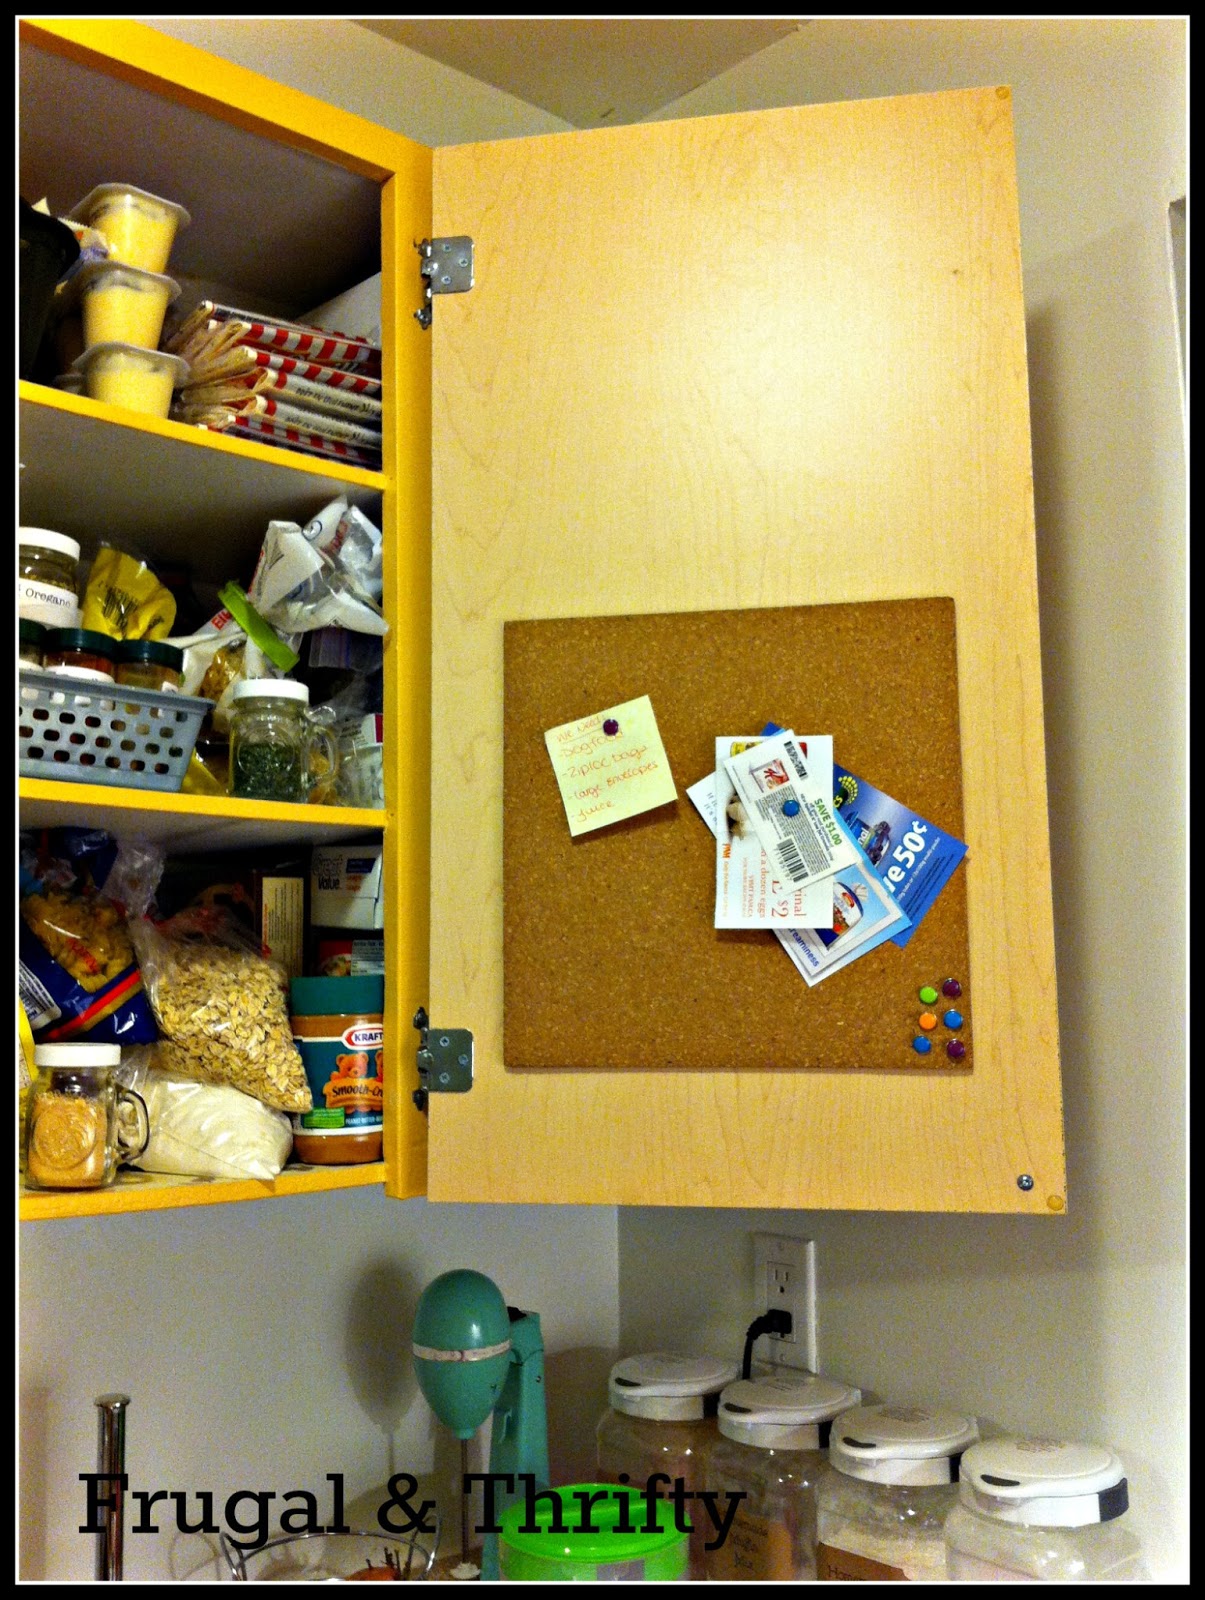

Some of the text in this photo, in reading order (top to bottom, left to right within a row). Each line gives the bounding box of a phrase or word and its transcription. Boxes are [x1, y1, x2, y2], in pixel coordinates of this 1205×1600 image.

[25, 588, 71, 608] Oregano
[814, 798, 843, 846] SAVE $1.00
[760, 868, 769, 895] dozen
[757, 898, 766, 918] eggs
[771, 900, 789, 918] $2
[787, 928, 820, 967] reaminess
[354, 1032, 384, 1042] KRAFT
